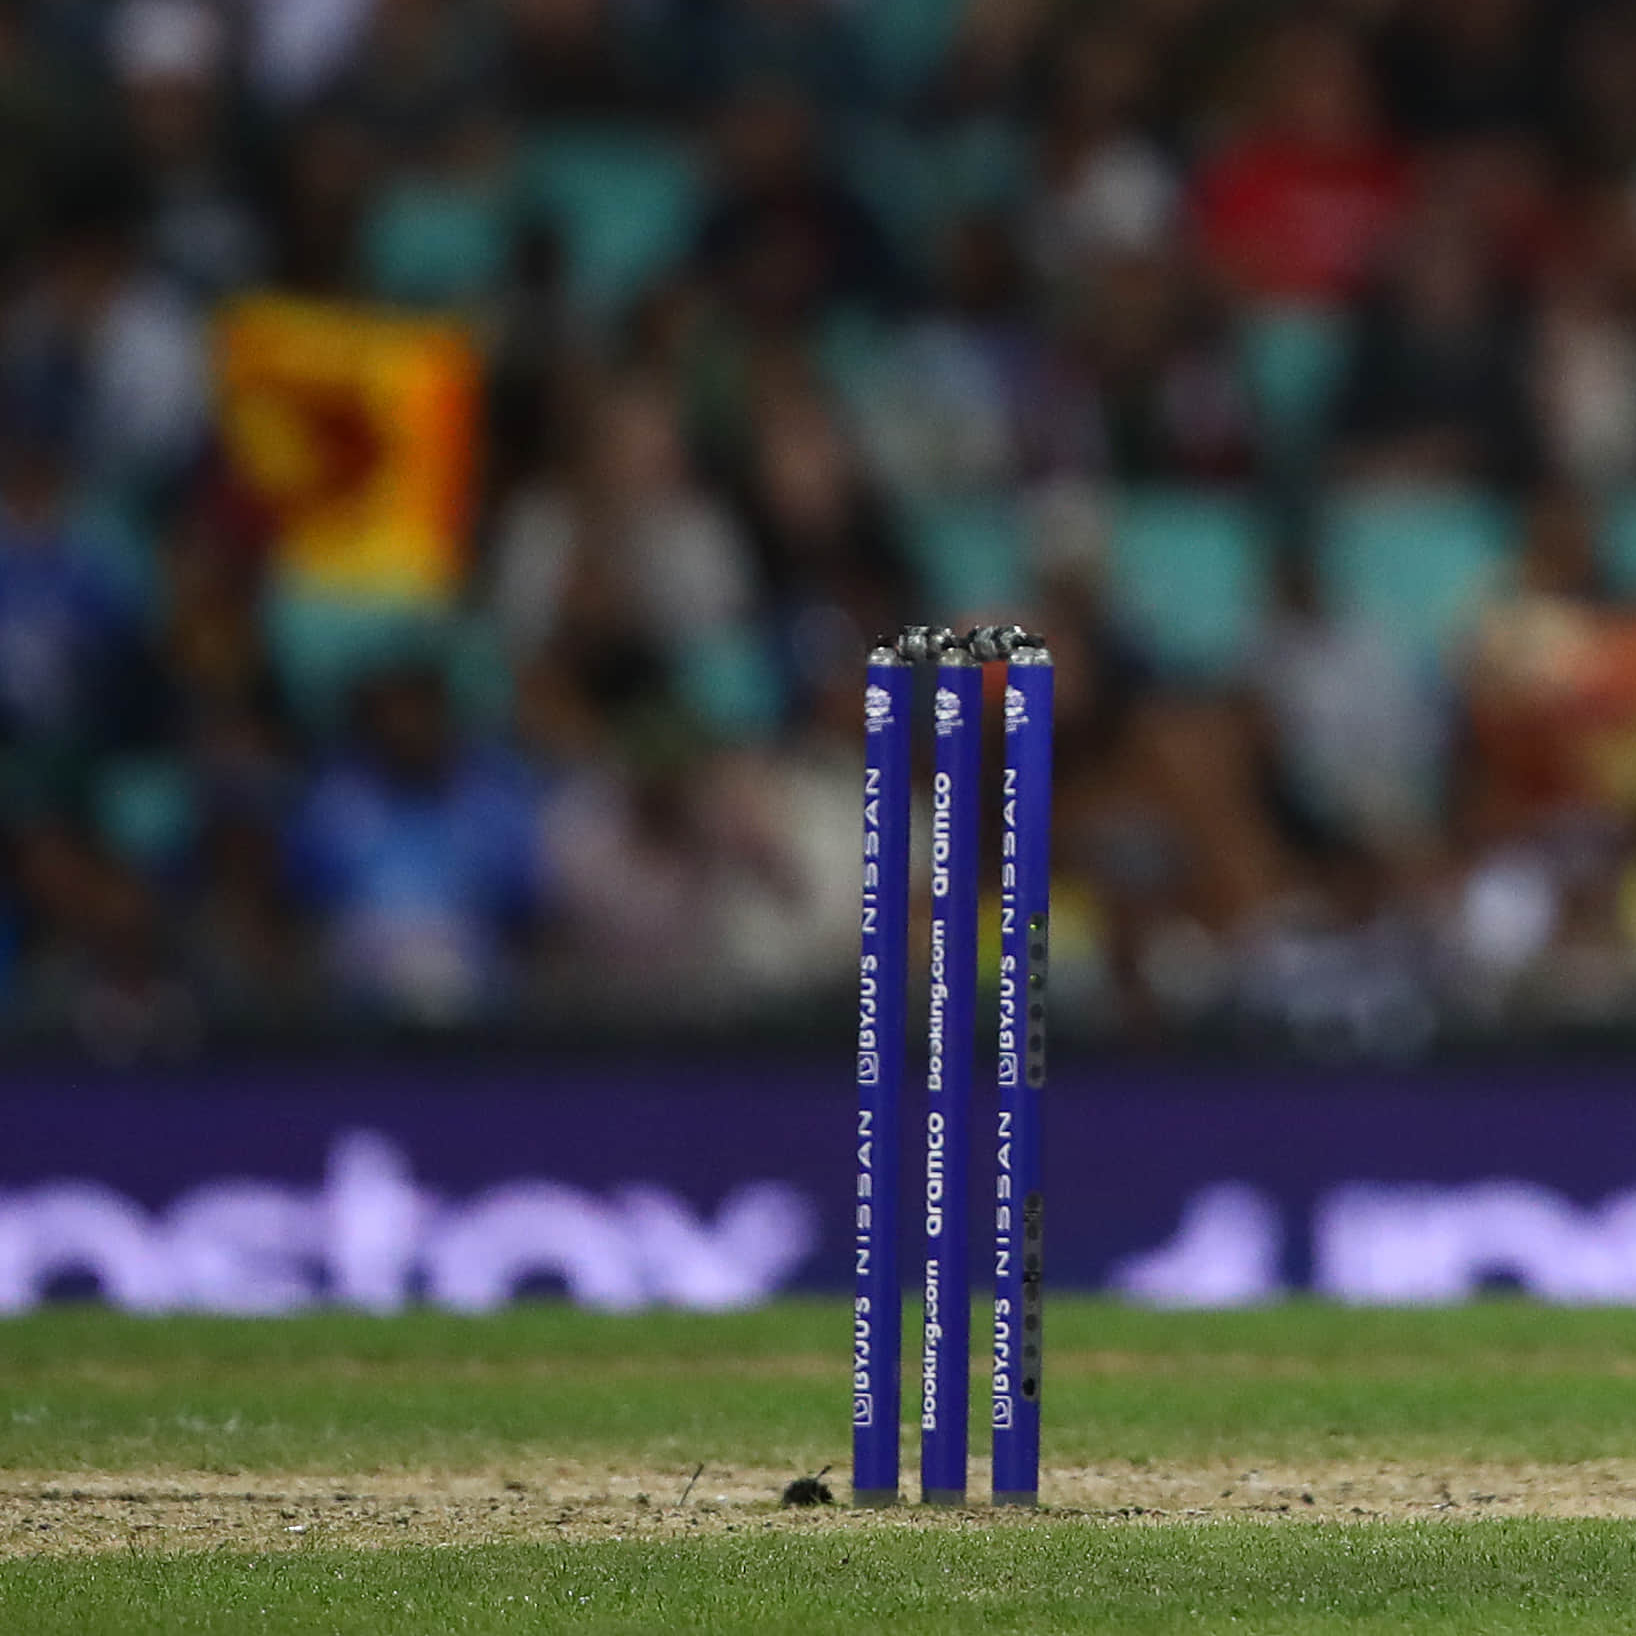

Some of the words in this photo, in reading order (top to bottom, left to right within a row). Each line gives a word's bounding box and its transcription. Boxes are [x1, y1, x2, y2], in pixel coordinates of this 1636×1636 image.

[862, 767, 881, 933] NISSAN
[932, 771, 952, 897] aramco
[1002, 768, 1018, 933] NISSAN
[858, 954, 879, 1050] BYJU'S
[999, 954, 1017, 1050] BYJU'S
[856, 1110, 873, 1276] NISSAN
[926, 1111, 945, 1237] aramco
[996, 1111, 1013, 1277] NISSAN
[853, 1296, 872, 1390] BYJU'S
[993, 1298, 1012, 1392] BYJU'S
